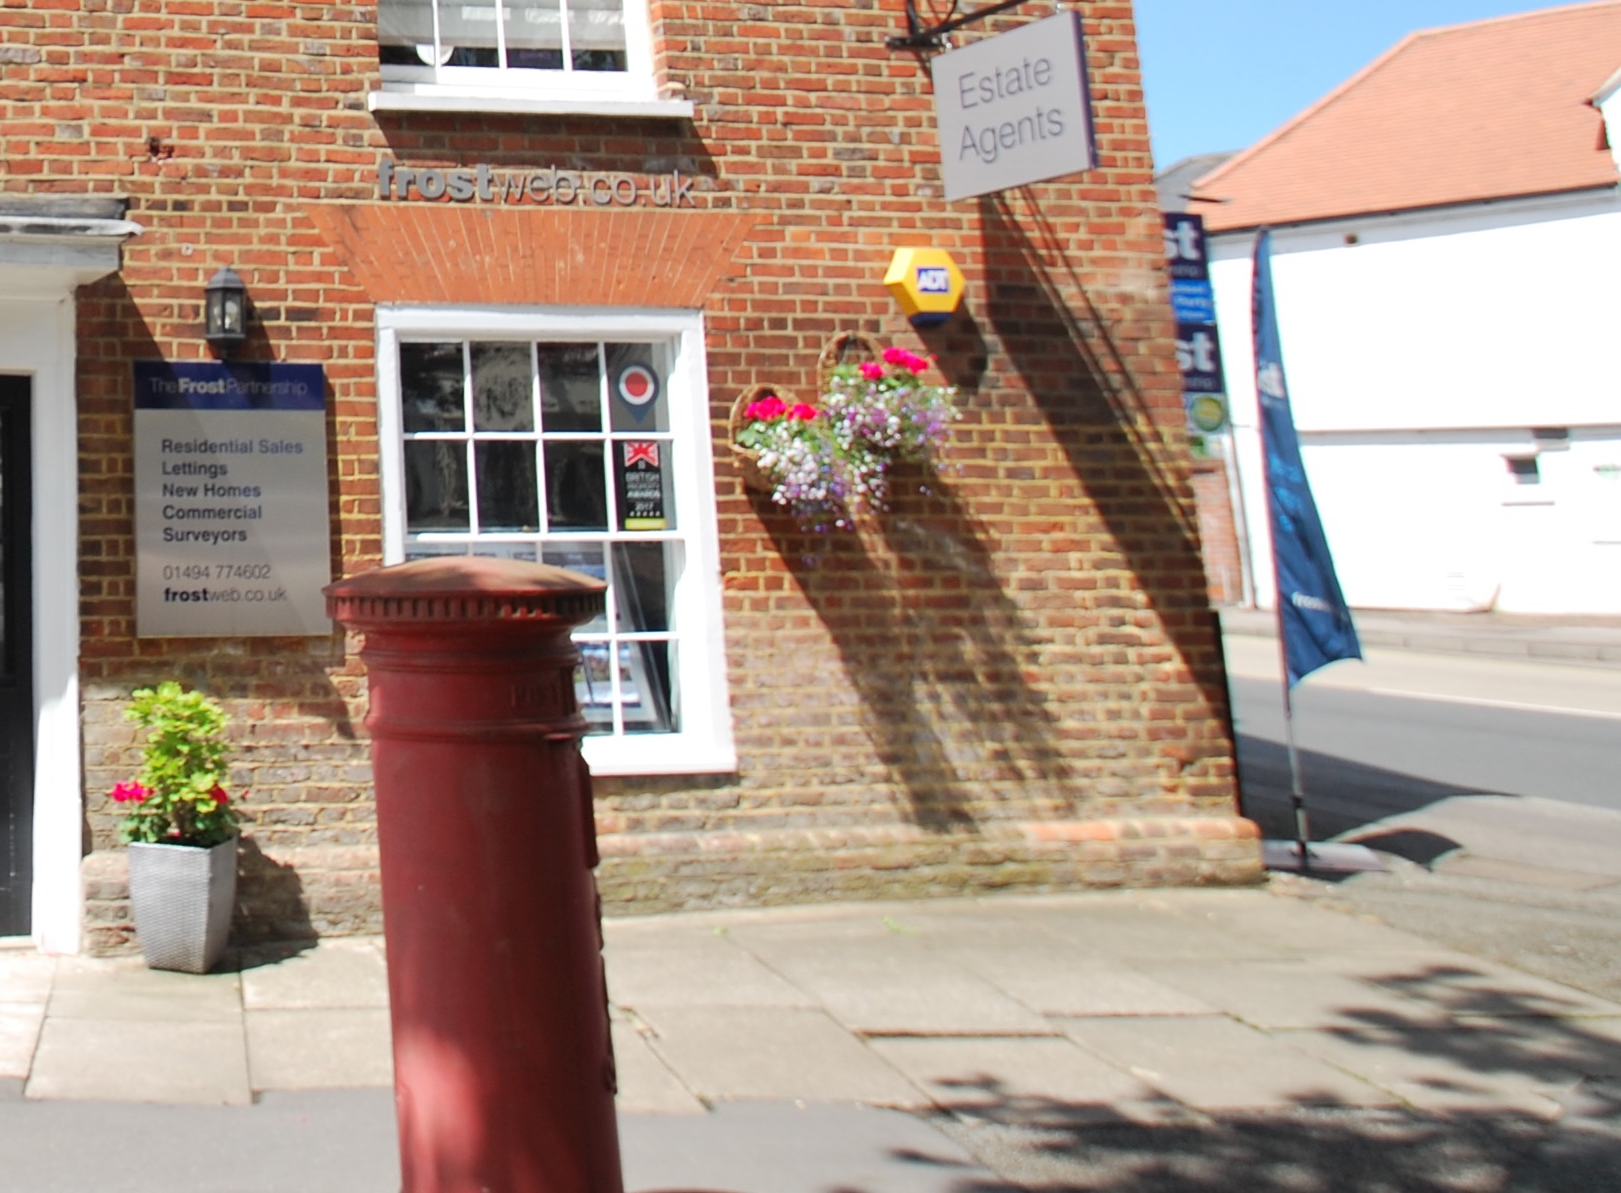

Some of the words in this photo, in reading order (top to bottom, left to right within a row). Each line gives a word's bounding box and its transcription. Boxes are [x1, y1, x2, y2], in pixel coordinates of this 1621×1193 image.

[958, 56, 1051, 109] Estate
[958, 107, 1064, 164] Agents
[377, 159, 696, 207] frostweb.co.uk
[918, 269, 948, 291] ADT
[150, 377, 176, 393] The
[177, 378, 225, 394] Frost
[226, 378, 308, 396] Partnership
[162, 439, 253, 453] Residential
[258, 439, 303, 454] Sales
[162, 461, 228, 479] Lettings
[162, 483, 198, 497] New
[203, 483, 261, 497] Homes
[162, 505, 262, 520] Commercial
[163, 527, 247, 546] Surveyors
[163, 565, 210, 580] 01494
[215, 564, 271, 579] 774602
[164, 587, 287, 602] frostweb.co.uk
